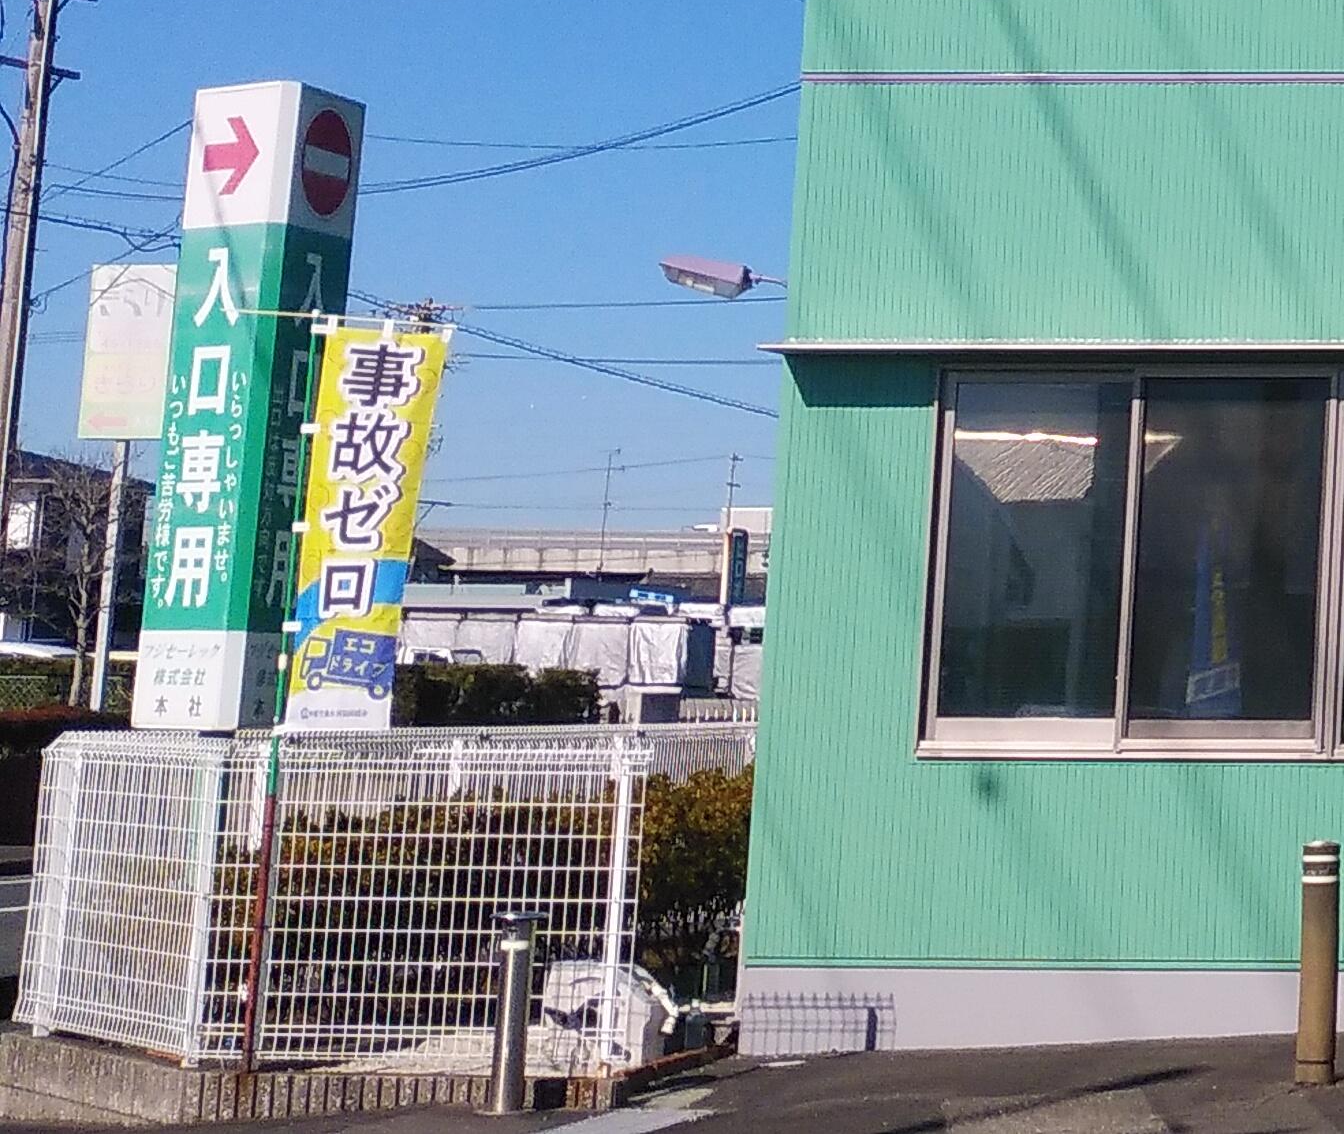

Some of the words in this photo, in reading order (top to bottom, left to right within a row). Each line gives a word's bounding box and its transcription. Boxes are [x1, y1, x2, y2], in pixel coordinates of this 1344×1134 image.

[150, 374, 187, 609] いつもご苦労様です。
[164, 247, 239, 607] 入口専用
[214, 370, 247, 582] いらっしゃいませ。
[320, 342, 418, 615] 事故ゼロ
[144, 643, 222, 659] フジセーレック
[153, 668, 206, 686] 株式会社
[343, 637, 376, 654] エコ
